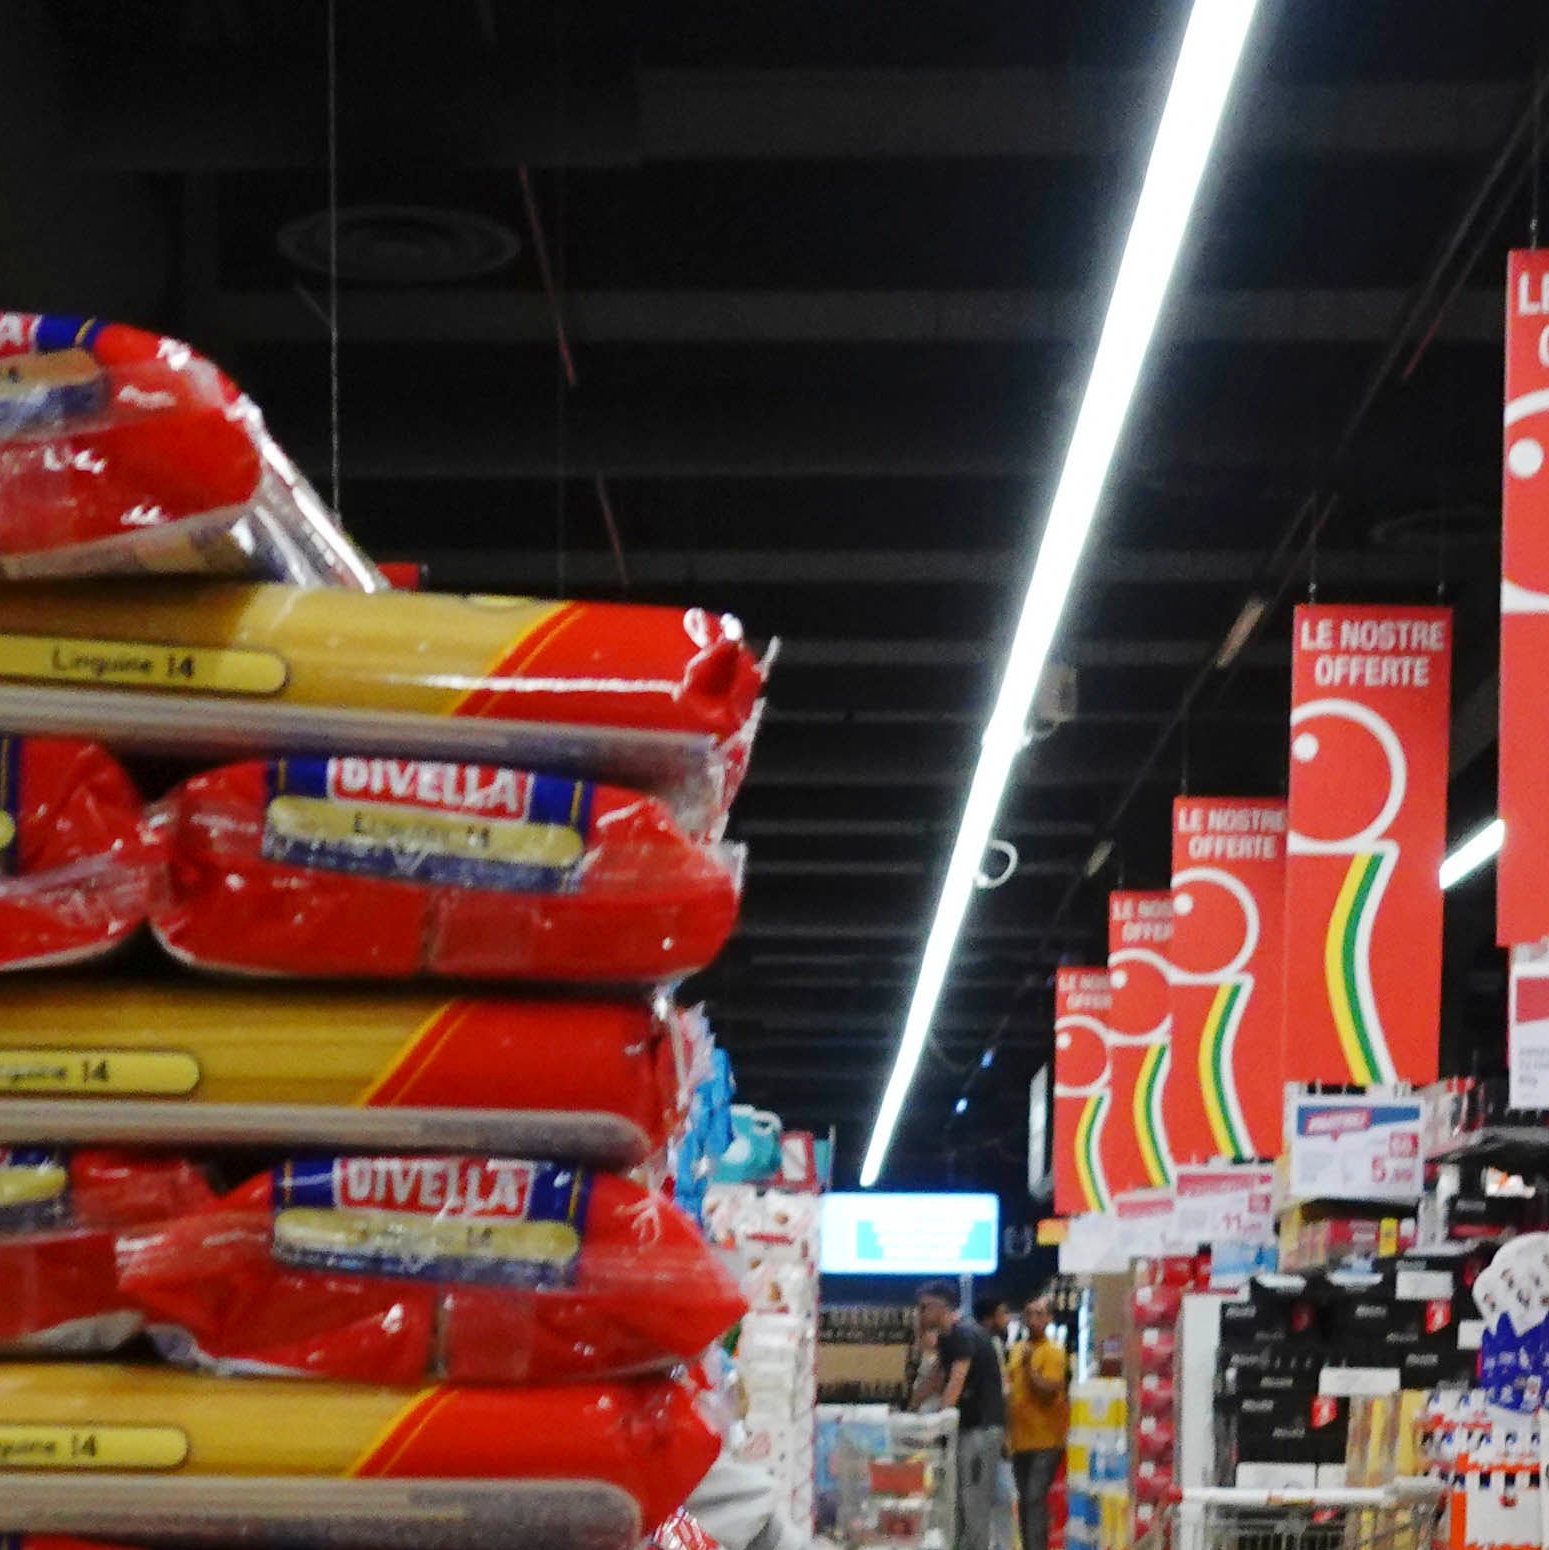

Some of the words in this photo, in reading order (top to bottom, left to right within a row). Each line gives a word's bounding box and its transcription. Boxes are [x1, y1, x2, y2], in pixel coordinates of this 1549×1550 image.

[1301, 619, 1333, 652] LE
[1340, 619, 1445, 652] NOSTRE
[52, 645, 154, 677] Linguine
[168, 653, 195, 679] 14
[1314, 656, 1430, 688] OFFERTE
[340, 757, 520, 815] DIVELLA
[1177, 807, 1203, 833] LE
[1188, 834, 1277, 860] OFFERTE
[1137, 899, 1173, 919] NOS
[1121, 921, 1174, 942] OFFER
[81, 1060, 110, 1081] 14
[345, 1160, 521, 1211] DIVELLA
[69, 1435, 98, 1457] 14
